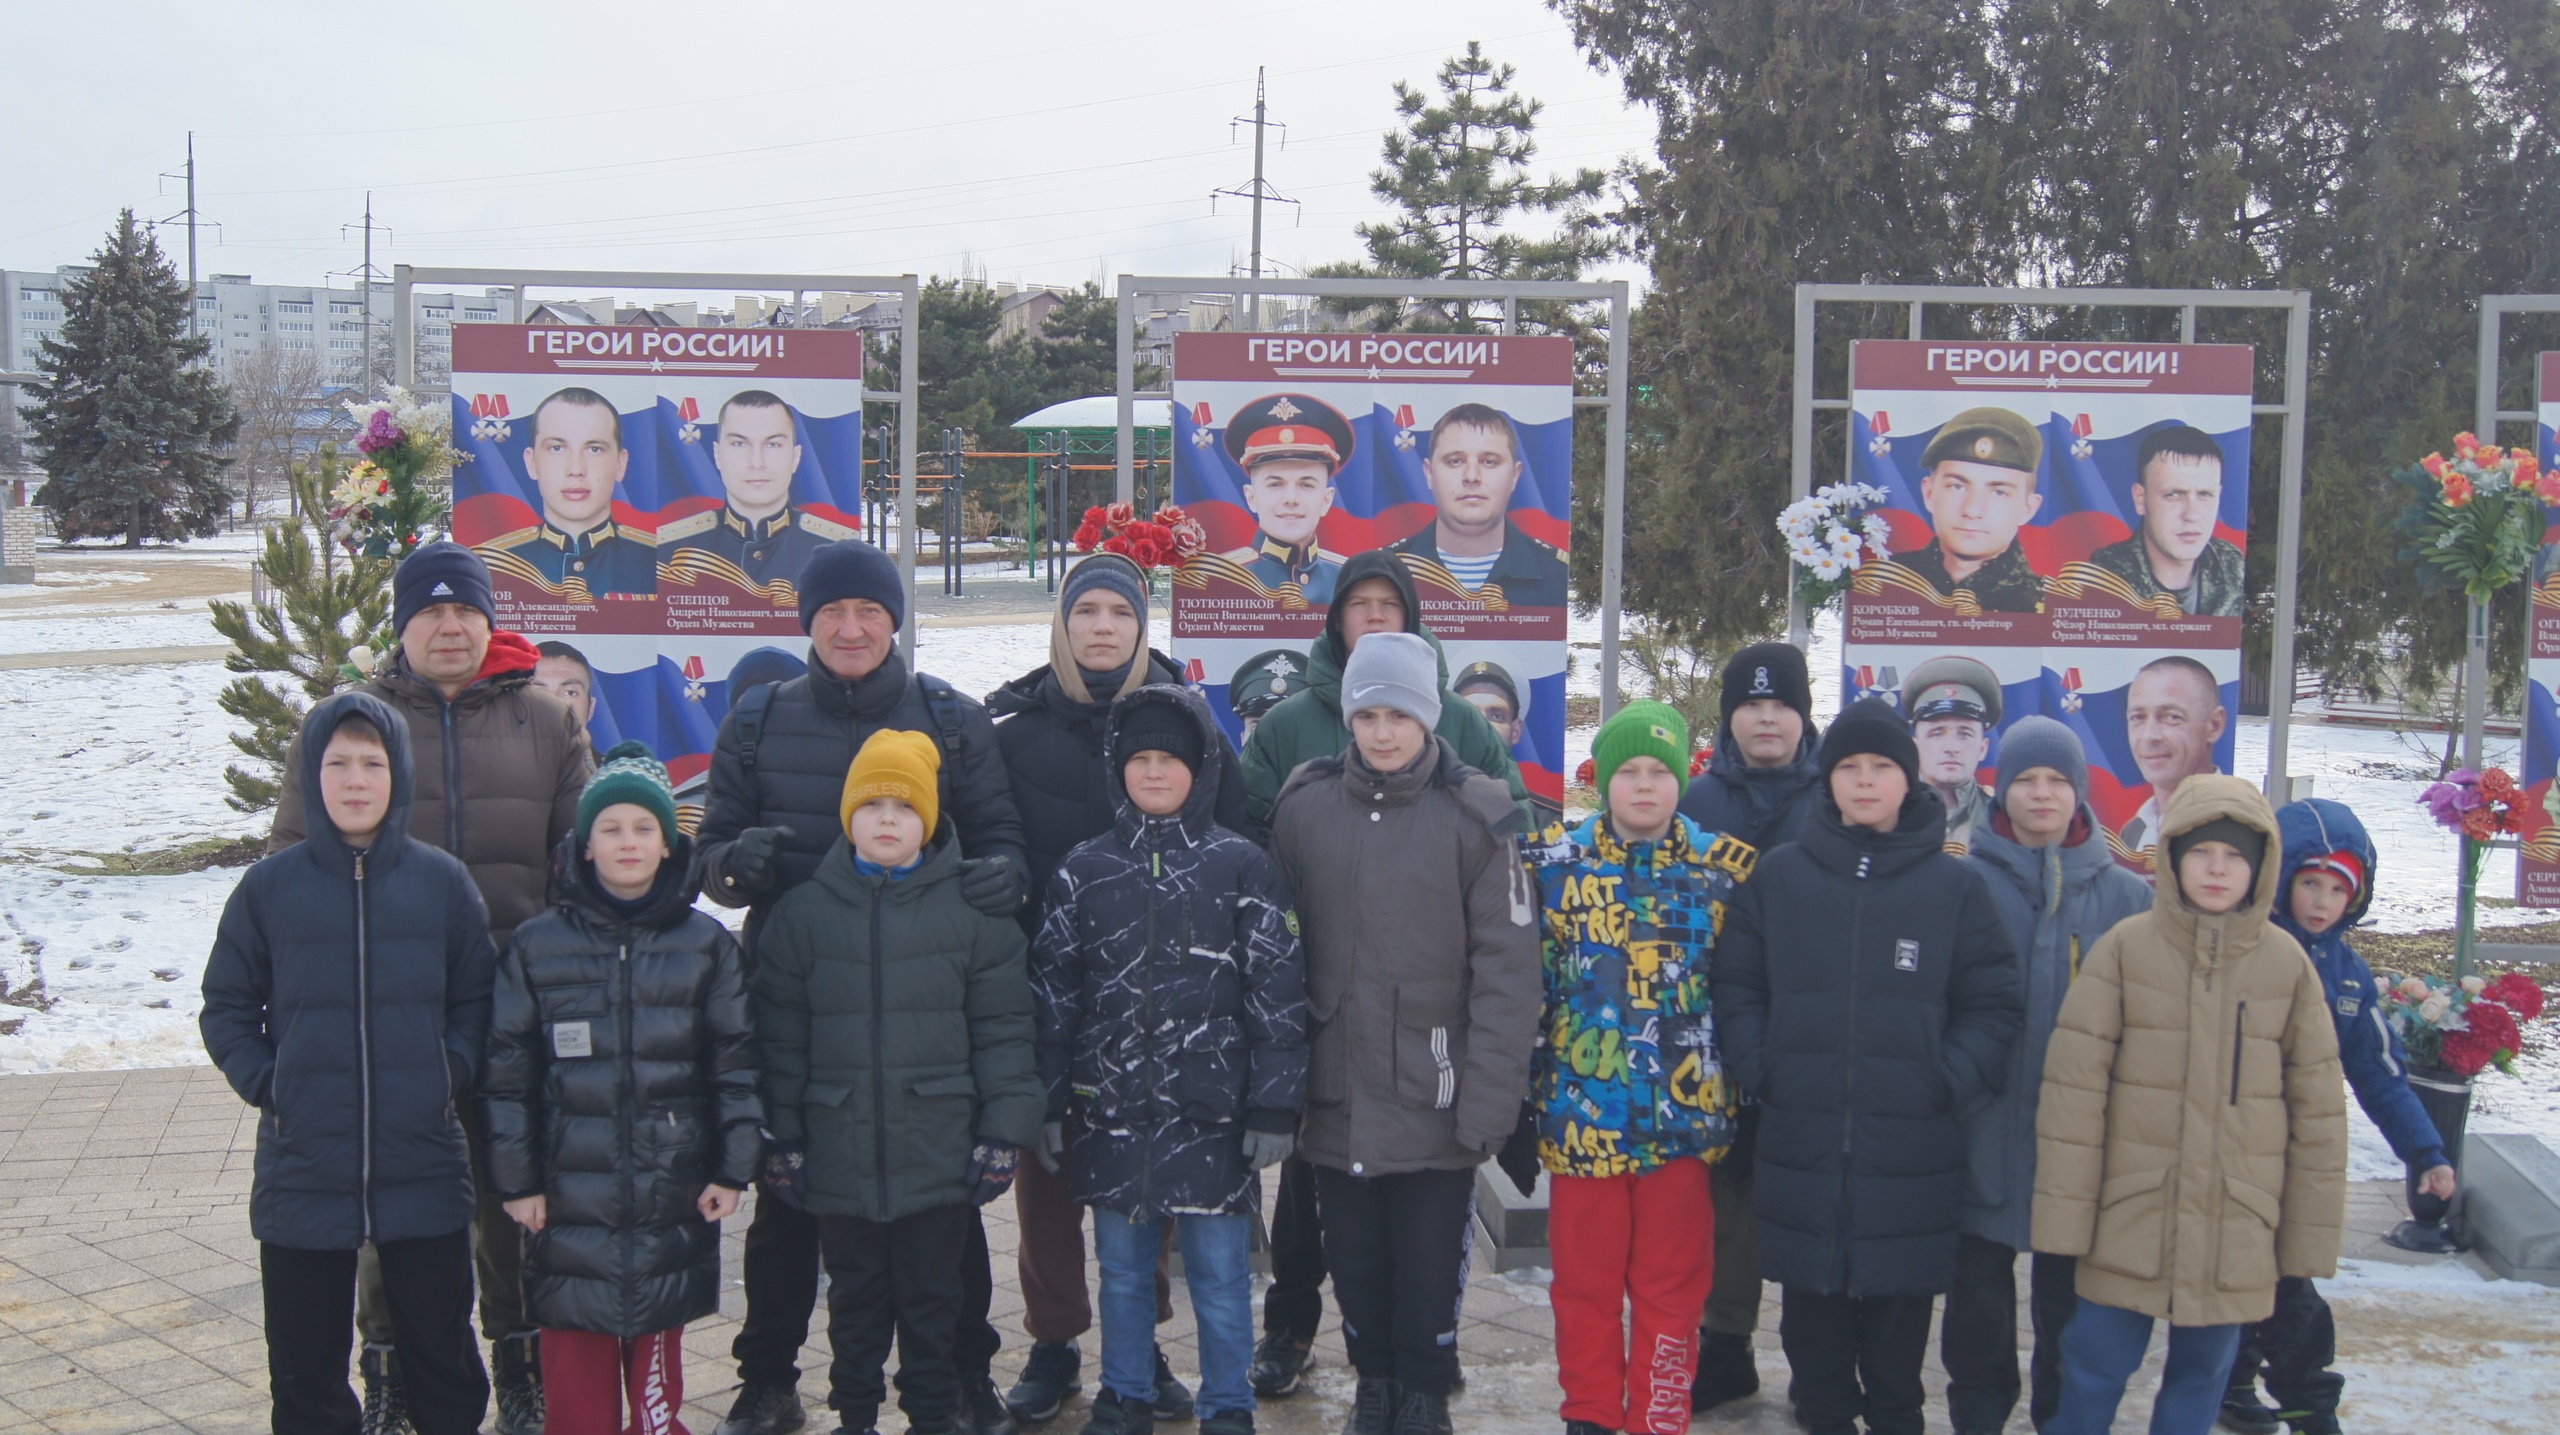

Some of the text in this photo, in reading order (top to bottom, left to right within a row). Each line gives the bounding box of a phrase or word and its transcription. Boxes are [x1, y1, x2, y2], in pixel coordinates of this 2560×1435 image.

[528, 330, 785, 358] ГЕРОИ РОССИИ!
[1248, 338, 1499, 365] ГЕРОИ РОССИИ!
[1927, 348, 2179, 374] ГЕРОИ РОССИИ!
[666, 595, 729, 606] СЛЕПЦОВ
[1178, 598, 1274, 609] ТЮТЮННИКОВ
[517, 600, 599, 614] Александрович,
[666, 606, 706, 618] Андрей
[708, 607, 773, 618] Николаевич,
[1852, 604, 1920, 615] КОРОБКОВ
[2052, 607, 2121, 619] ДУДЧЕНКО
[524, 613, 577, 621] лейтенант
[1178, 610, 1219, 622] Кирилл
[1222, 611, 1284, 622] Витальевич,
[1420, 614, 1492, 624] лександрович,
[1509, 615, 1550, 624] сержант
[524, 621, 576, 633] Мужества
[666, 618, 755, 630] Орден Мужества
[1178, 621, 1264, 633] Орден Мужества
[1428, 624, 1465, 633] жества
[1852, 616, 1884, 627] Роман
[1962, 617, 2013, 630] ефрейтор
[2170, 623, 2212, 633] сержант
[1852, 627, 1938, 640] Орден Мужества
[2052, 630, 2138, 642] Орден Мужества
[1561, 873, 1623, 911] ART
[1563, 1120, 1623, 1159] ART
